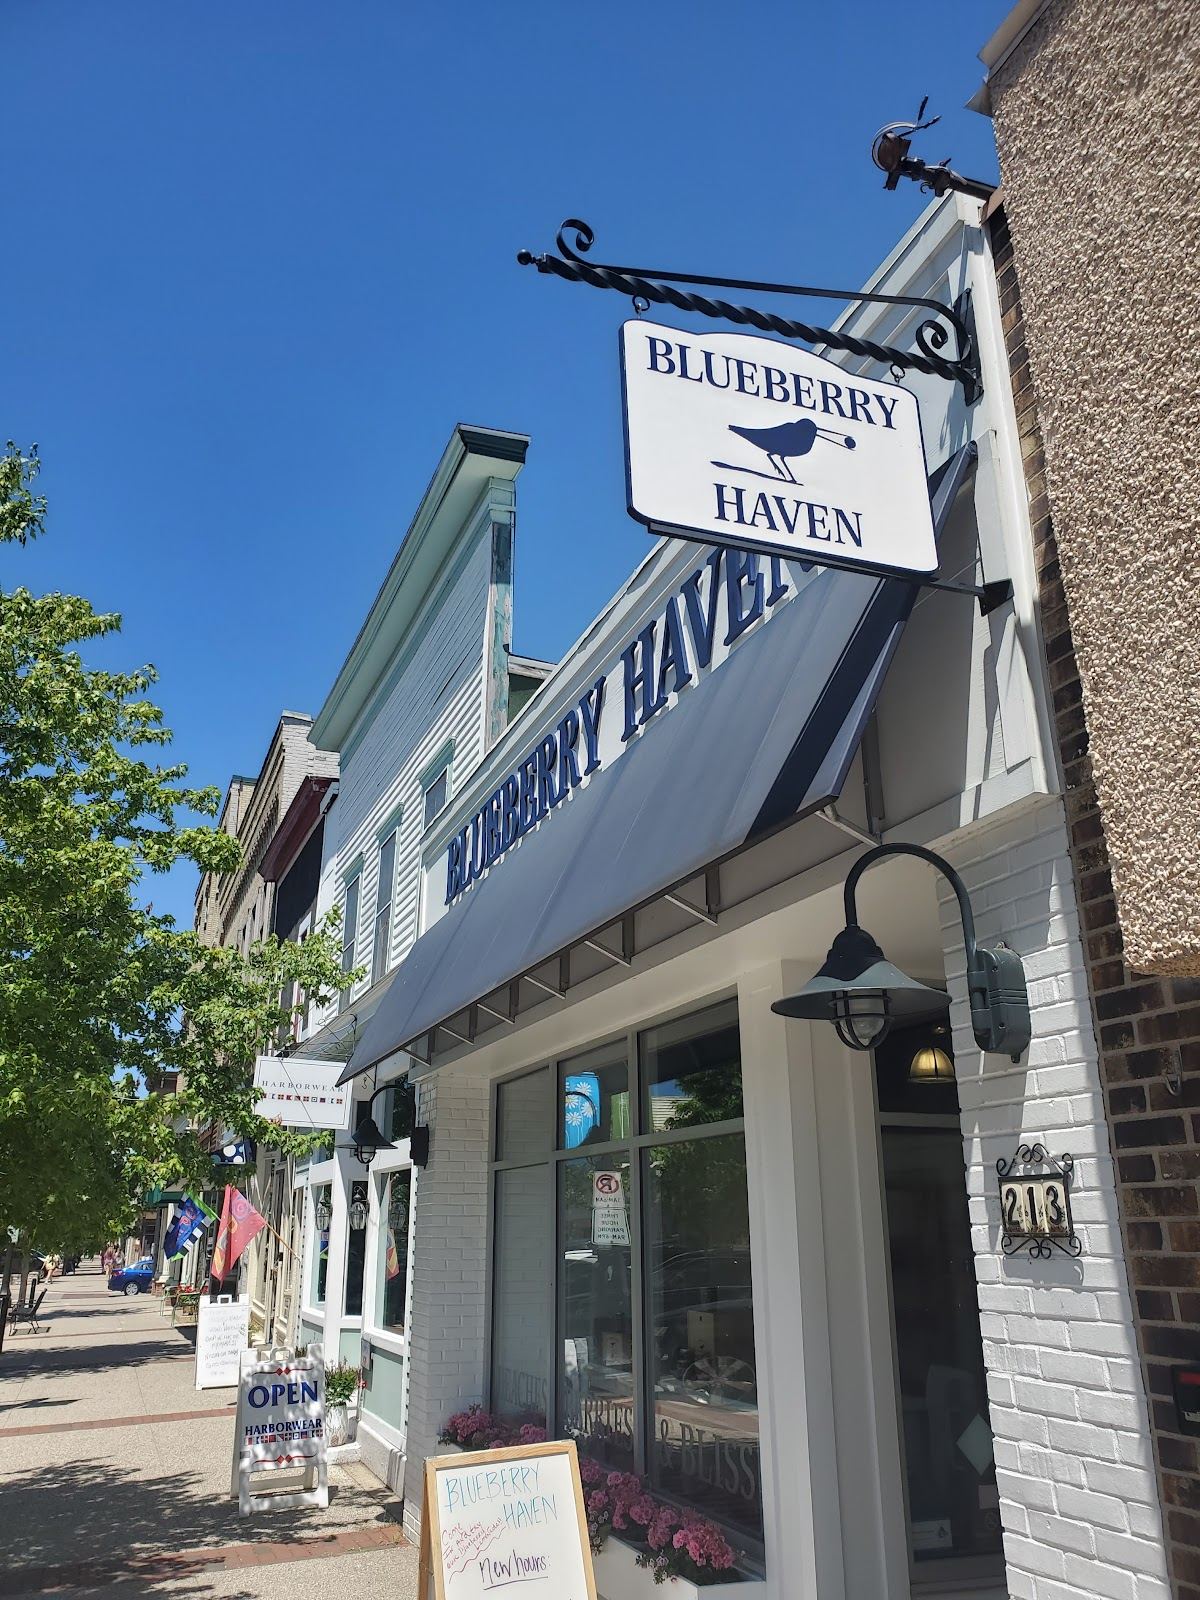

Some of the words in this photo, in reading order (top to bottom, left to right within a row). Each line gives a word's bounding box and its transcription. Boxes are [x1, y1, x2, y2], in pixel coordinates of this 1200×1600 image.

[645, 335, 899, 430] BLUEBERRY
[713, 483, 863, 548] HAVEN
[445, 675, 607, 905] BLUEBERRY
[261, 1080, 344, 1093] HARBORWEAR
[1005, 1185, 1062, 1226] 213
[248, 1380, 319, 1409] OPEN
[245, 1418, 323, 1436] HARBORWEAR
[567, 1393, 634, 1444] RRIES
[680, 1422, 756, 1501] BLISS
[444, 1463, 541, 1513] BLUEBERRY
[503, 1493, 558, 1530] HAVEN
